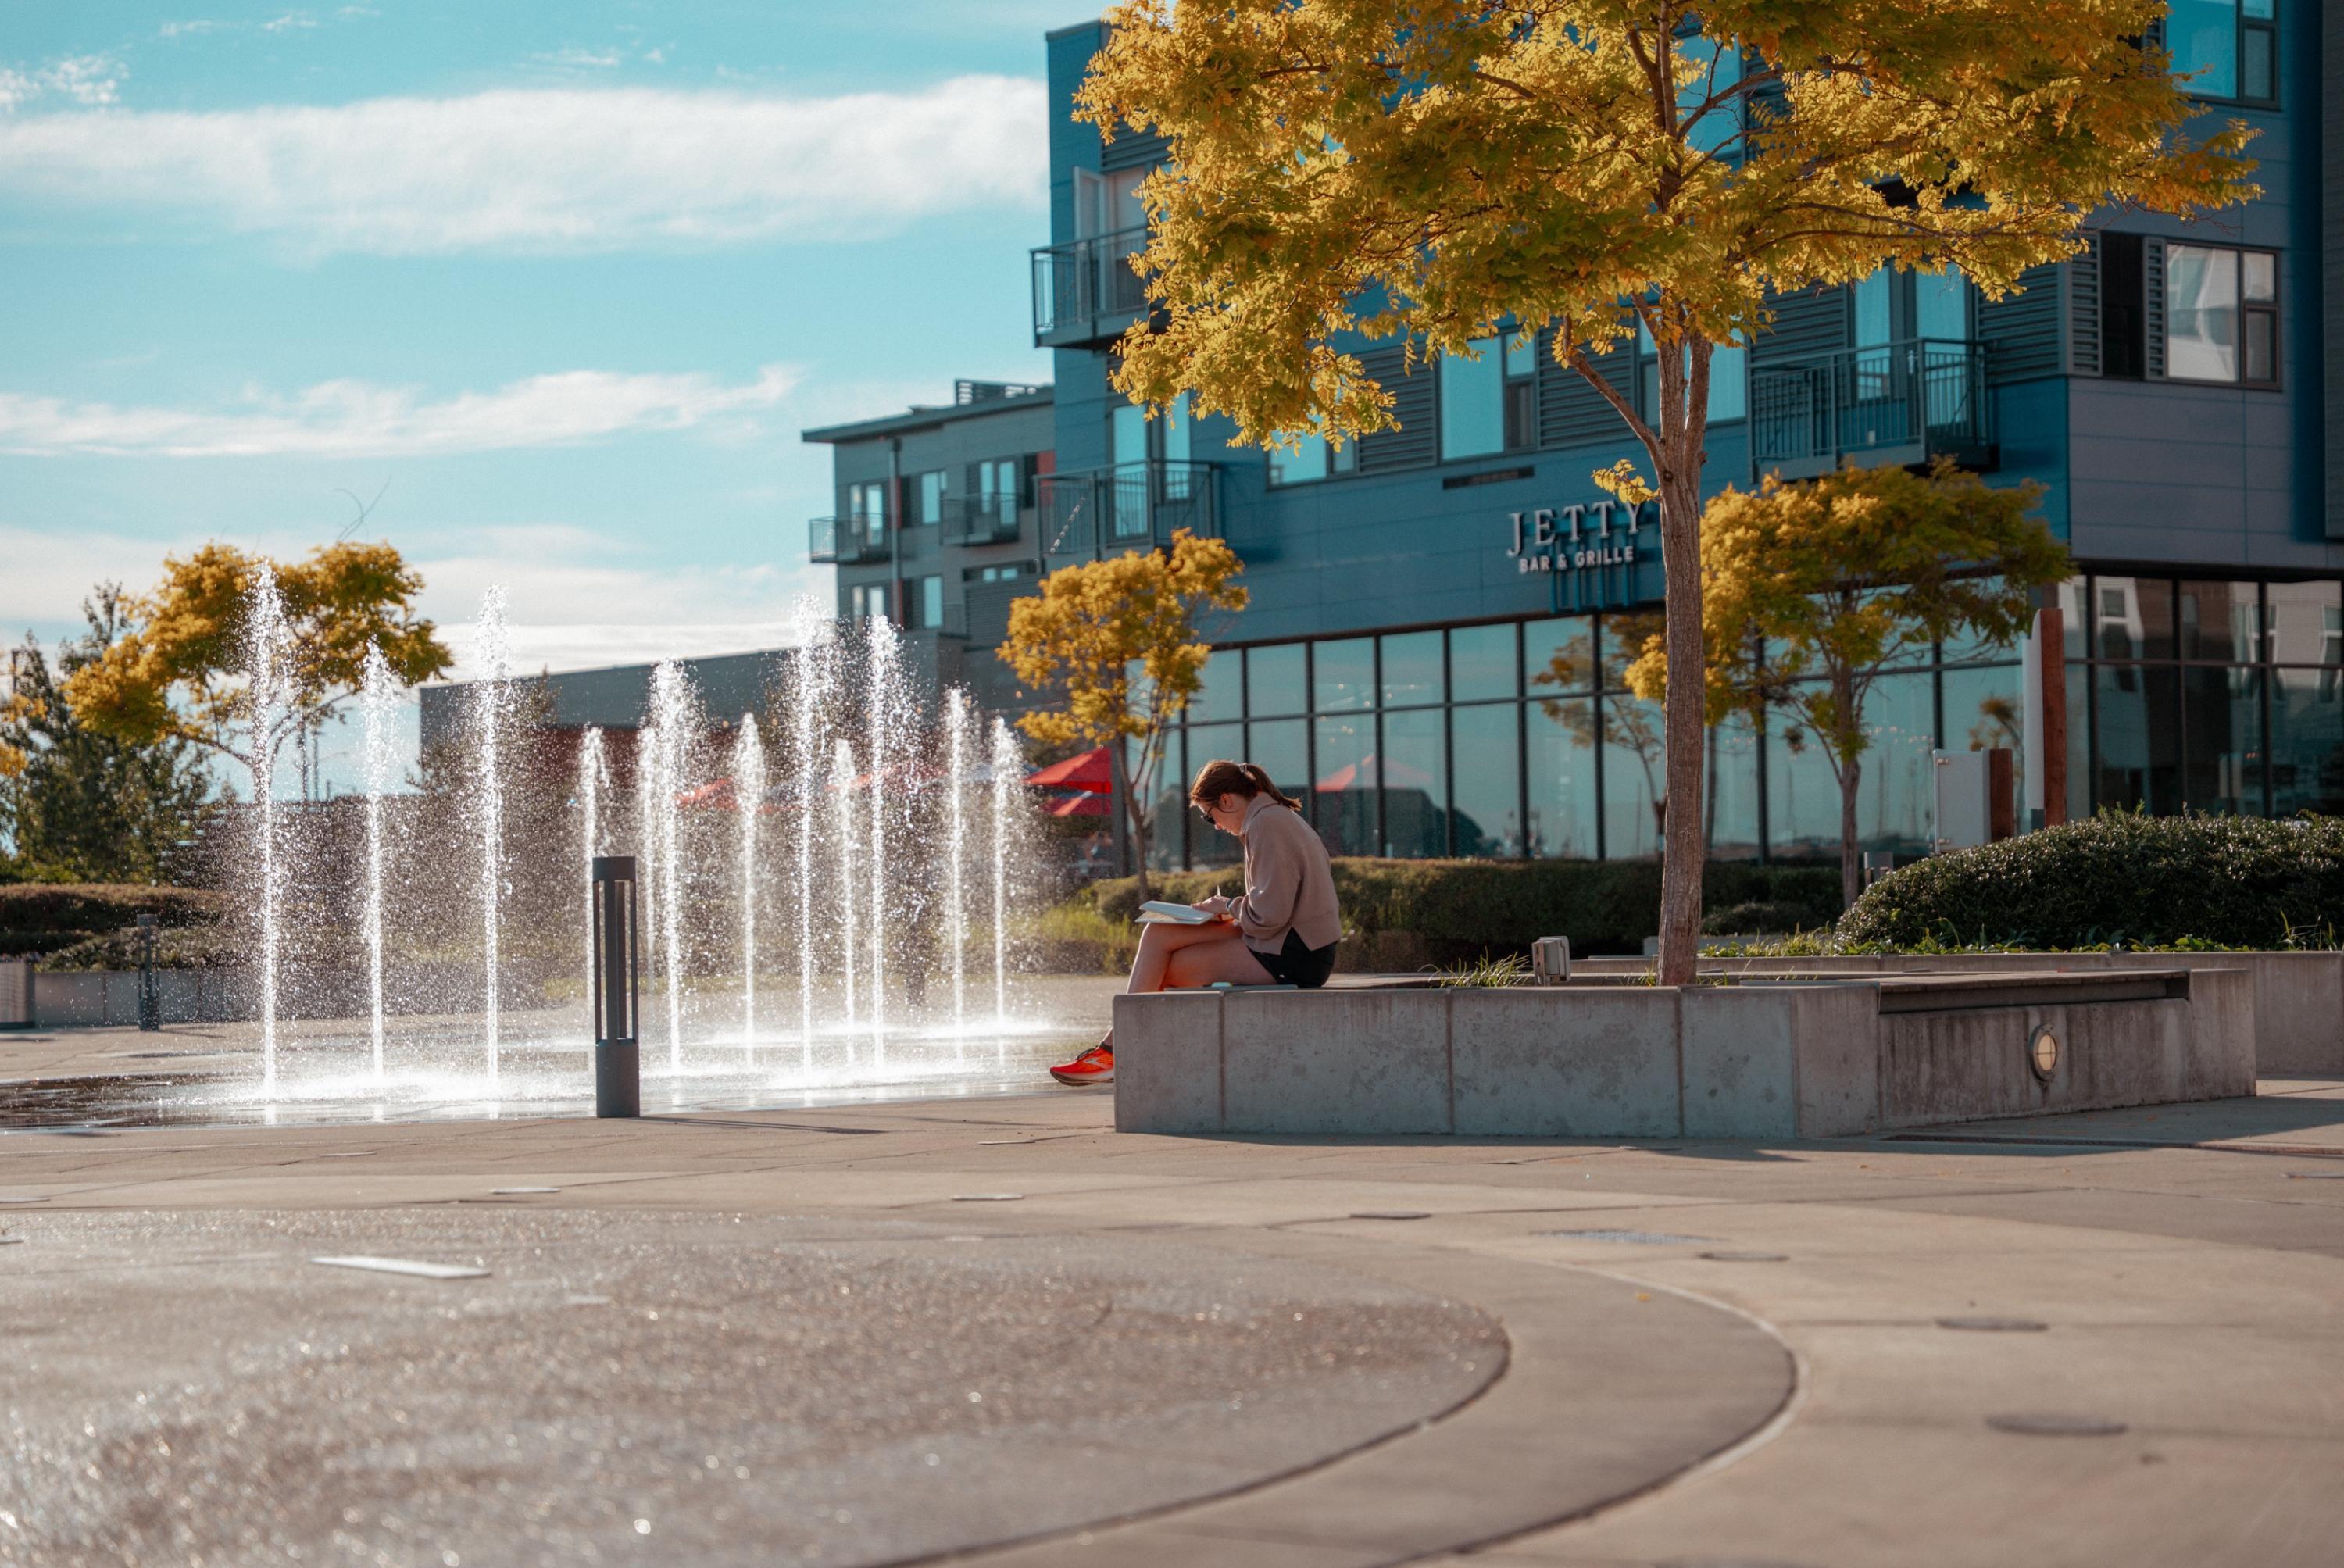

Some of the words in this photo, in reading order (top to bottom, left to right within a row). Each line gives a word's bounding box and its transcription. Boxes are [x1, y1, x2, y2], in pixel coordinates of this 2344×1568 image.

[1506, 500, 1642, 557] JETTY
[1519, 555, 1550, 573] BAR
[1557, 553, 1567, 570] &
[1574, 545, 1635, 569] GRILLE
